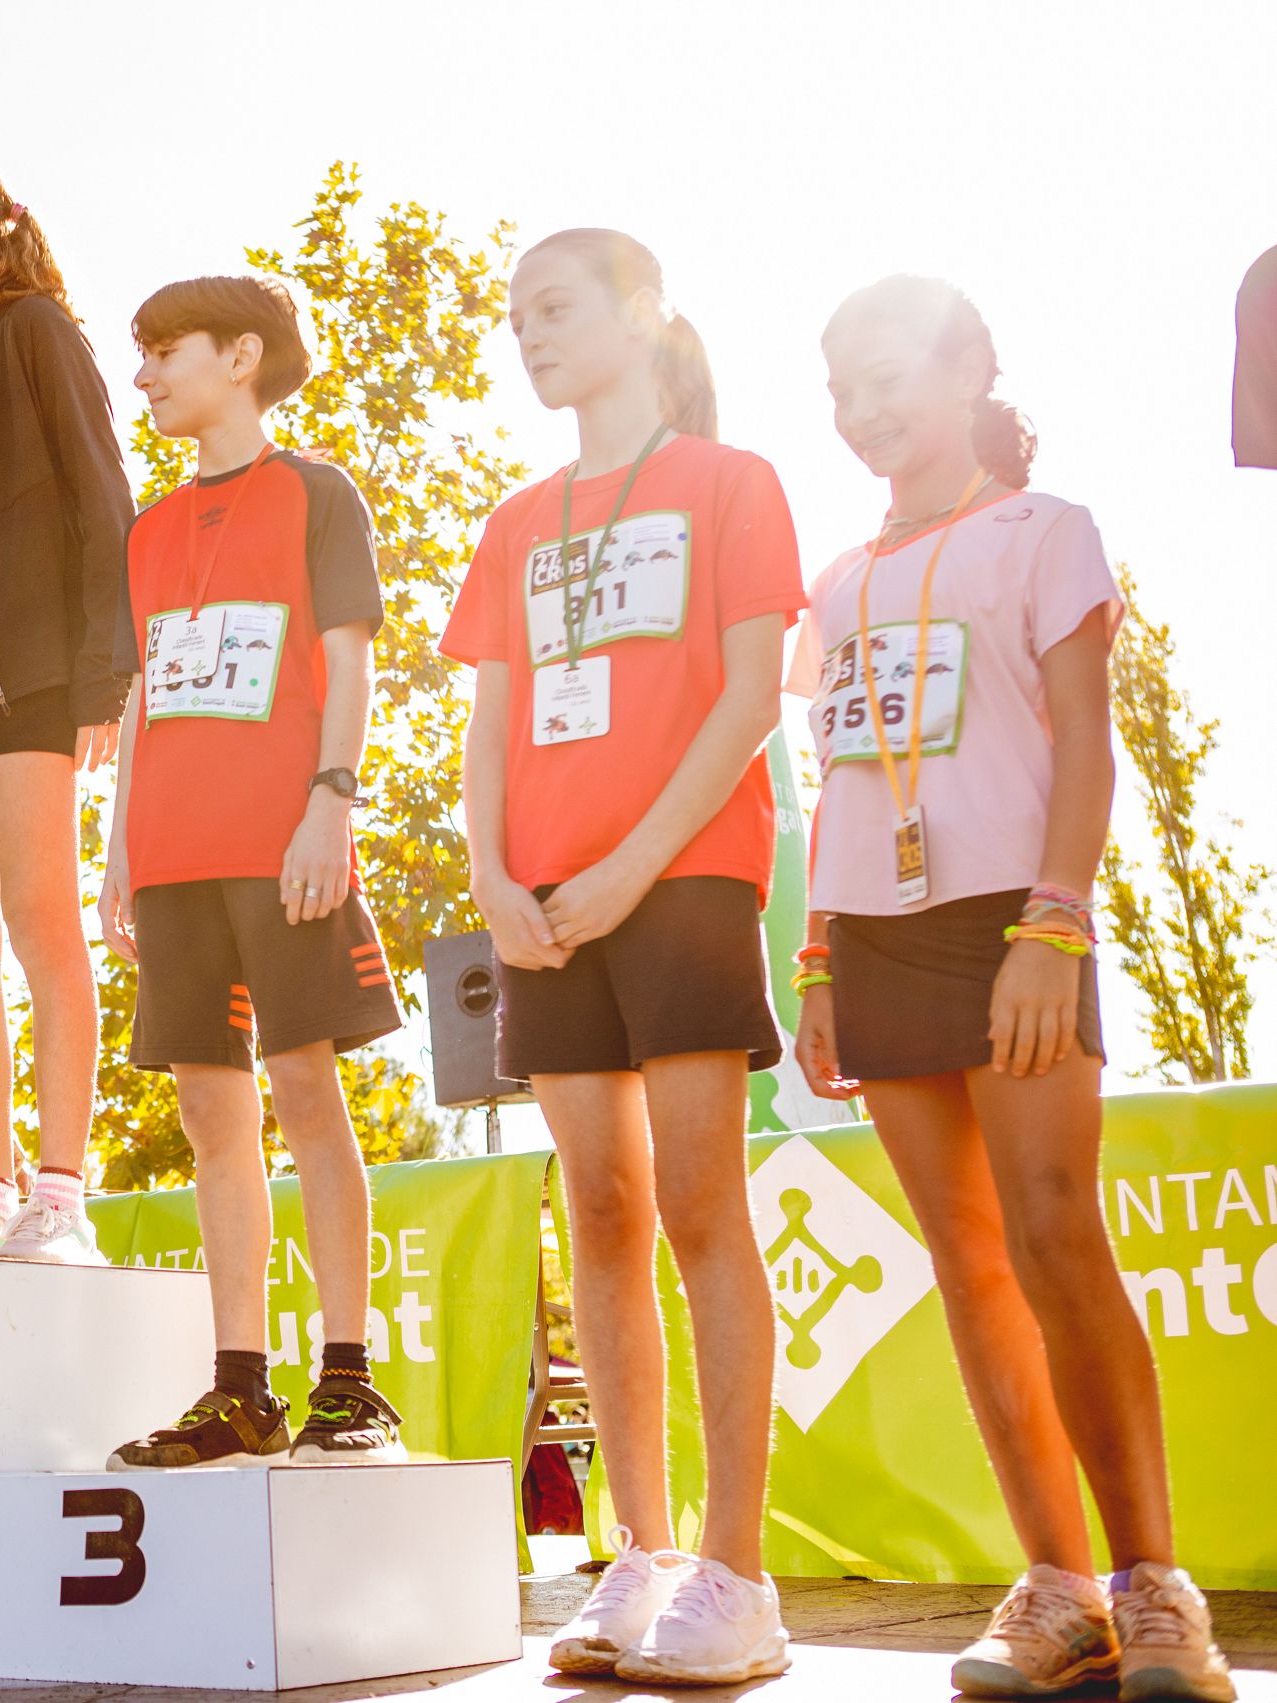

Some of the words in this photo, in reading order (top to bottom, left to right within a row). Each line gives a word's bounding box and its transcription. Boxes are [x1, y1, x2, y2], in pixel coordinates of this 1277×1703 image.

[562, 581, 627, 627] 811
[370, 1228, 431, 1279] DE
[59, 1487, 147, 1607] 3
